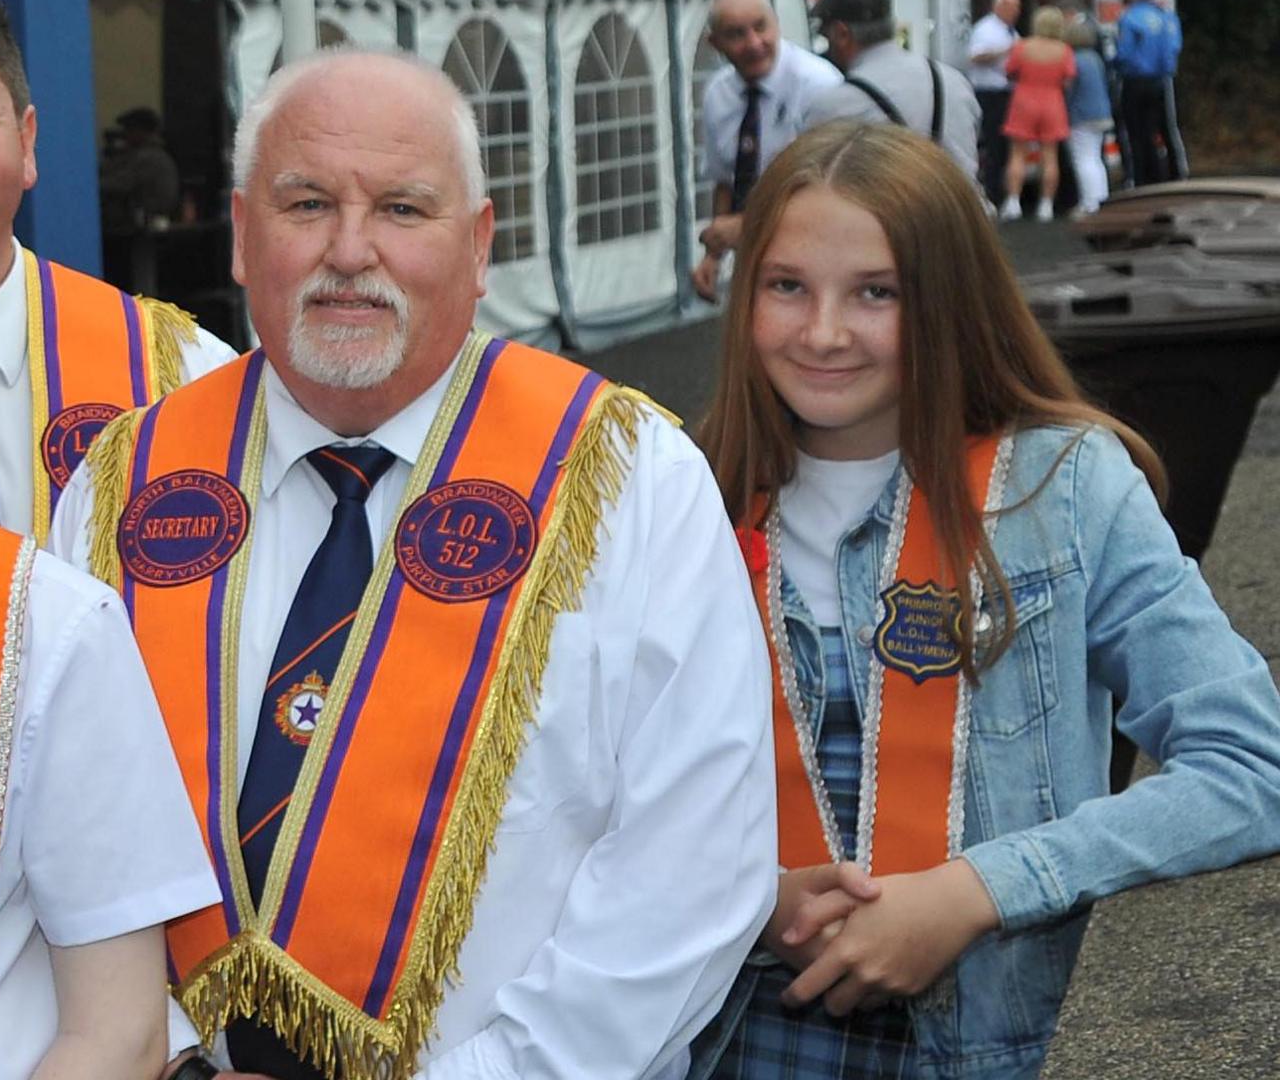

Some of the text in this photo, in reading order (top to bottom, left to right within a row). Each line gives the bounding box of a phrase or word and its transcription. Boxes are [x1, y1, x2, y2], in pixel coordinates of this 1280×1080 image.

[59, 408, 117, 429] BRAIDW
[125, 476, 240, 531] NORTH BALLYMENA
[430, 486, 526, 527] BRAIDWATER
[142, 515, 220, 539] SECRETARY
[437, 509, 497, 545] L.O.L.
[402, 546, 510, 594] PURPLE STAR
[438, 541, 480, 569] 512
